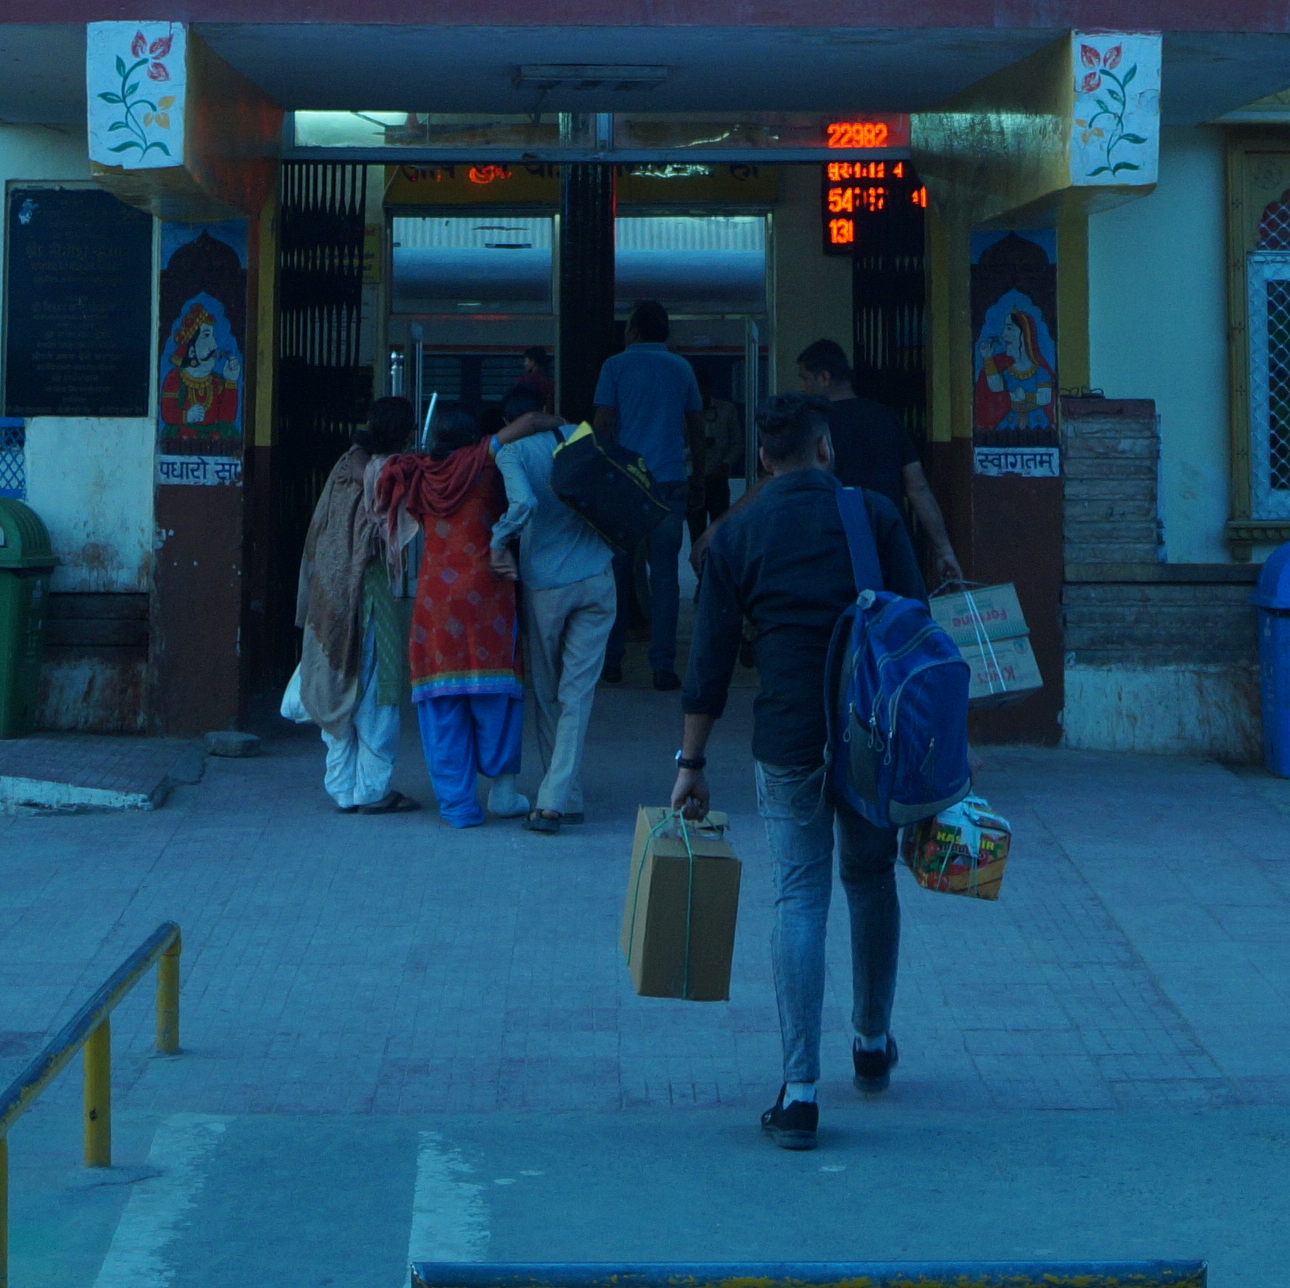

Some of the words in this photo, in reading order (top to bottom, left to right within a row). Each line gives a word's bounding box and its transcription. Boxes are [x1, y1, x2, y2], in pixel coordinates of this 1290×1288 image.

[827, 122, 888, 148] 22982
[159, 456, 210, 479] पधारो
[936, 831, 995, 851] KASIR
